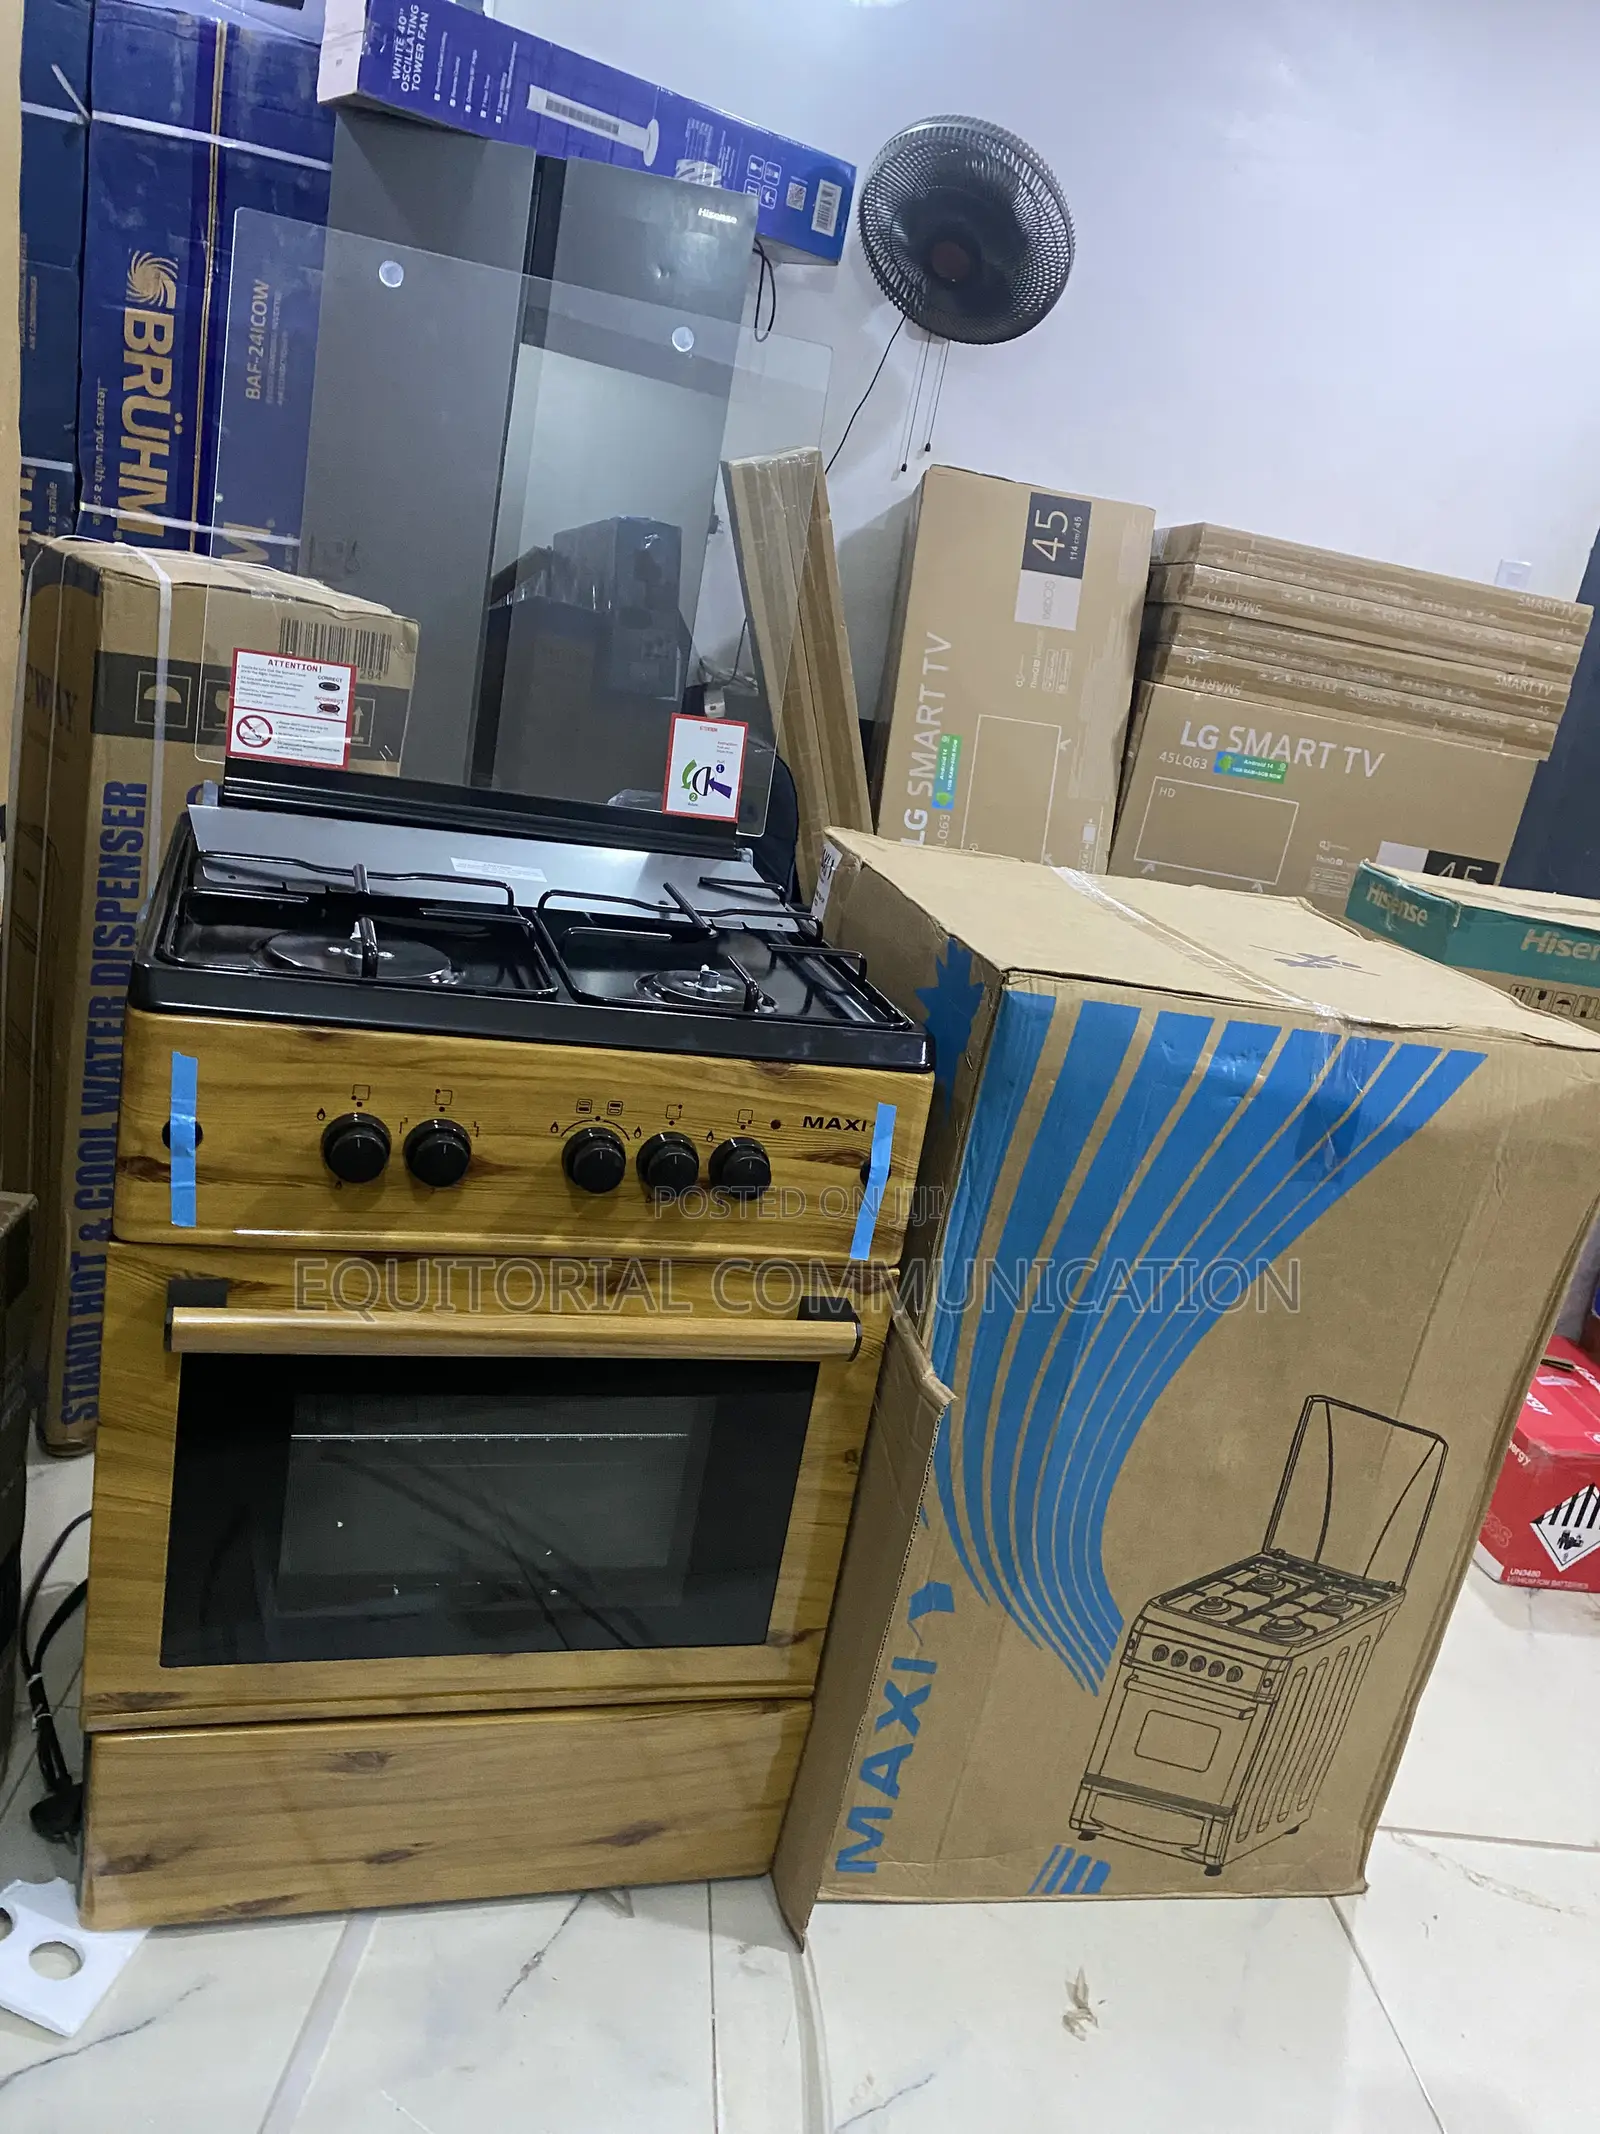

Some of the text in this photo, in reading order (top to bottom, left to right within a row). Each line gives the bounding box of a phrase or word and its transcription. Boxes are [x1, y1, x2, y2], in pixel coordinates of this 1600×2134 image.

[392, 36, 405, 80] WHITE
[401, 4, 420, 92] OSCILLATING
[411, 12, 430, 91] TOWER FAN
[117, 307, 184, 538] BRÜHM
[94, 430, 105, 452] you
[93, 454, 106, 482] with
[91, 495, 103, 526] sle
[1033, 509, 1070, 563] 45
[1069, 546, 1079, 561] 114
[1203, 593, 1263, 615] SMART TV
[1518, 595, 1580, 619] SMART TV
[267, 658, 323, 674] ATTENTION!
[317, 675, 343, 684] CORRECT
[1182, 675, 1242, 696] SMART TV
[1495, 674, 1554, 696] SMART TV
[901, 632, 952, 847] LG SMART TV
[1180, 720, 1385, 778] LG SMART TV
[1159, 751, 1208, 770] 45LQ63
[1243, 758, 1265, 767] Android
[1159, 787, 1176, 798] HD
[936, 813, 951, 848] LQ63
[1365, 881, 1429, 927] Hisense
[61, 782, 148, 1425] STAND HOT & COOL WATER DISPENSER
[802, 1116, 867, 1132] MAXI
[835, 1656, 938, 1873] MAXI
